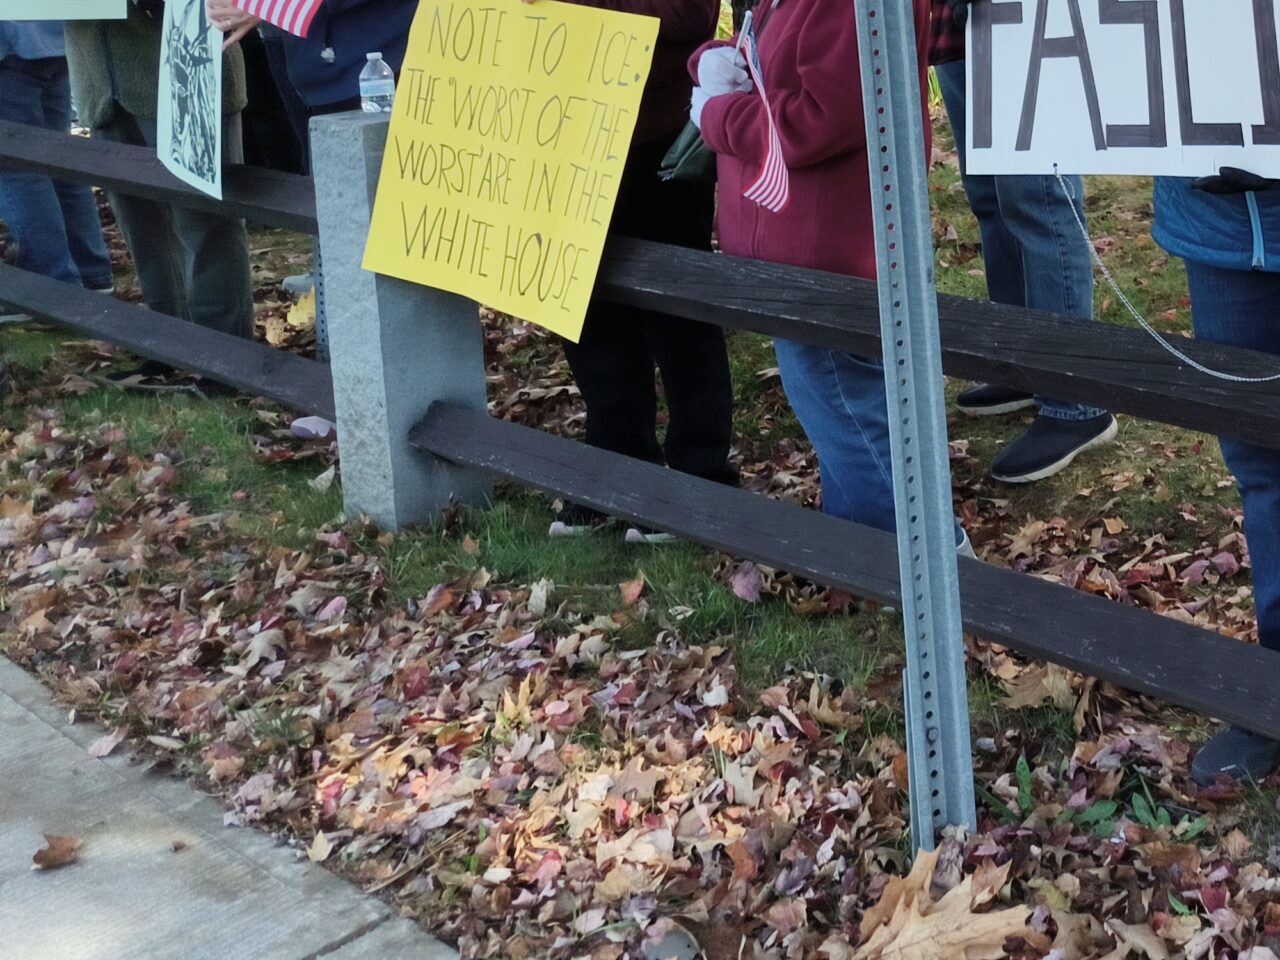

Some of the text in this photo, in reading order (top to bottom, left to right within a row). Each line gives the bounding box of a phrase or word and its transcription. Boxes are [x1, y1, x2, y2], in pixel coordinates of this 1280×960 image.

[427, 3, 650, 87] NOTE TO ICE:
[406, 68, 441, 126] THE
[536, 94, 588, 152] OF
[581, 98, 629, 162] THE
[523, 158, 561, 214] IN
[563, 162, 613, 226] THE
[400, 200, 590, 313] WHITE HOUSE
